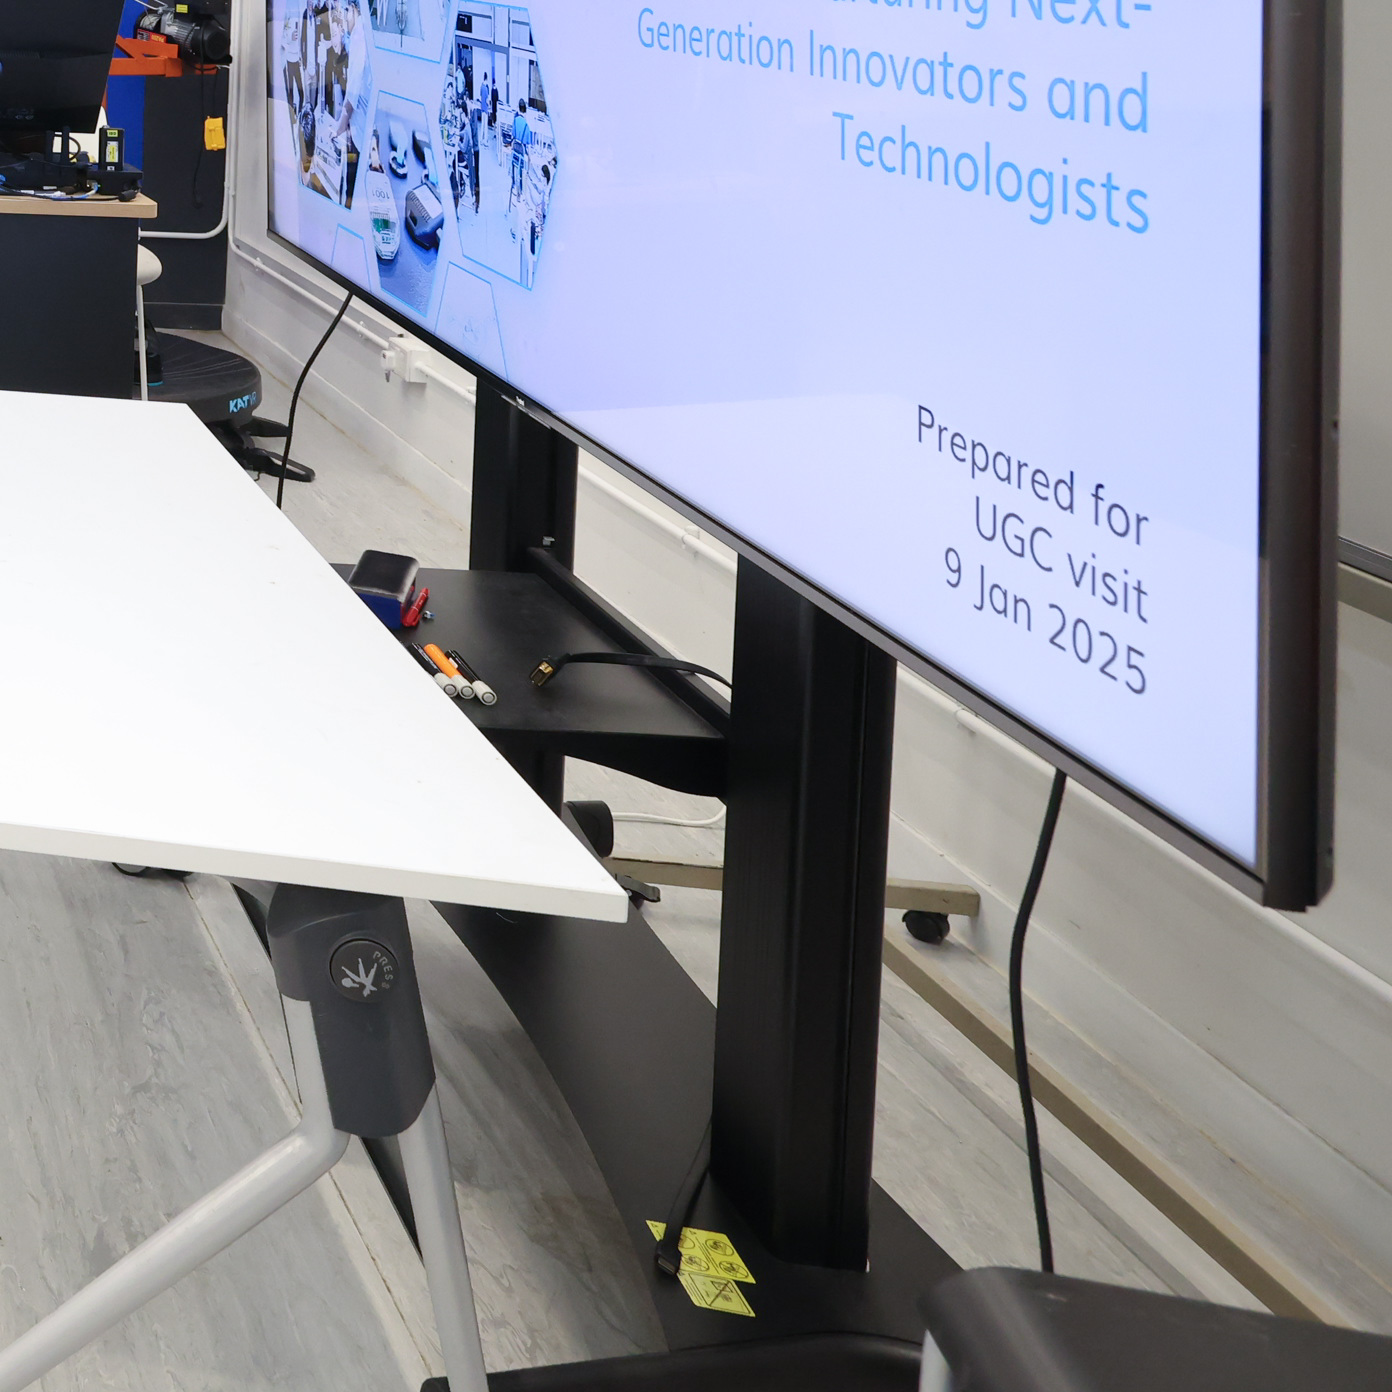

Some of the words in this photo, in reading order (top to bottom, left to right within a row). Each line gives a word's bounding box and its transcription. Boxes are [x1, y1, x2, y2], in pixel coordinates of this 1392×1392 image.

[637, 7, 794, 73] Generation
[808, 28, 1028, 112] Innovators
[1047, 70, 1149, 134] and
[832, 111, 1150, 235] Technologists
[918, 404, 1075, 514] Prepared
[1091, 483, 1149, 546] for
[944, 547, 962, 588] 9
[973, 564, 1032, 632] Jan
[1048, 603, 1146, 695] 2025
[975, 495, 1053, 573] UGC
[1067, 552, 1148, 624] visit
[373, 951, 394, 989] PRESS
